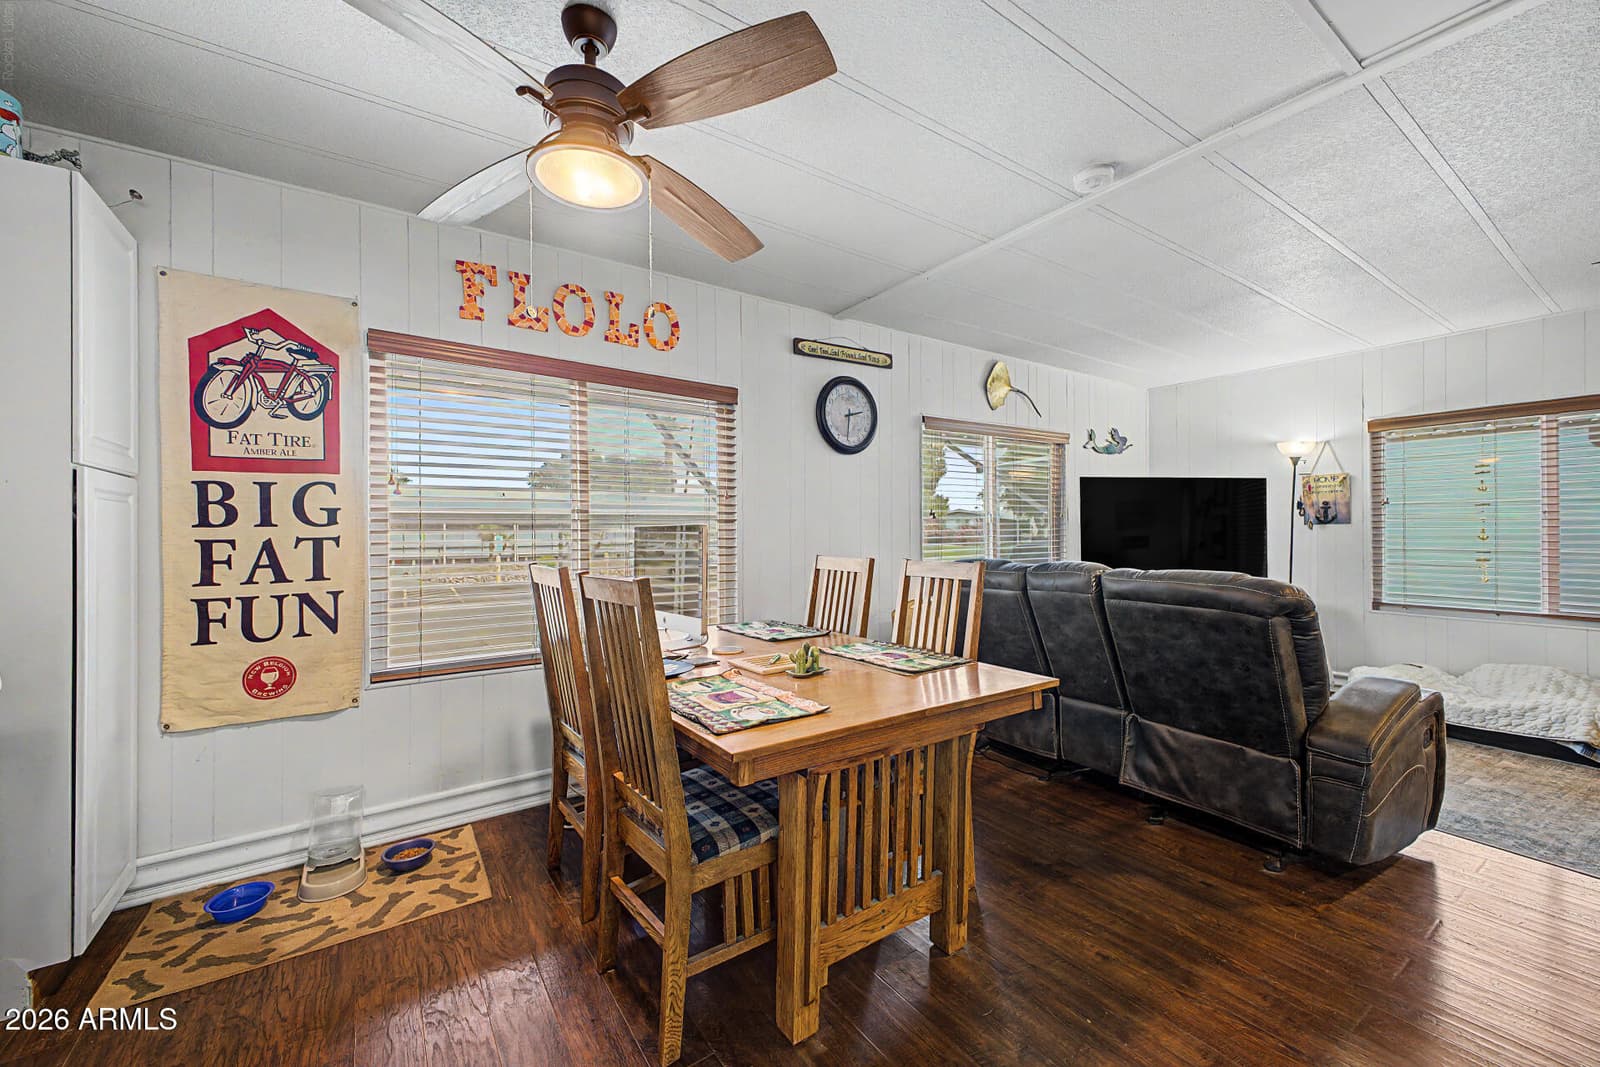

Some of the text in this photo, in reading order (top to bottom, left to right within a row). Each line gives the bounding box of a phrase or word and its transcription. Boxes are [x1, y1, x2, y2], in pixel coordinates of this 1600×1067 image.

[455, 259, 680, 352] FLOLO
[226, 430, 312, 448] FAT TIRE
[243, 446, 297, 457] AMBER ALE
[191, 480, 341, 528] BIG
[192, 535, 341, 587] FAT
[190, 590, 344, 646] FUN
